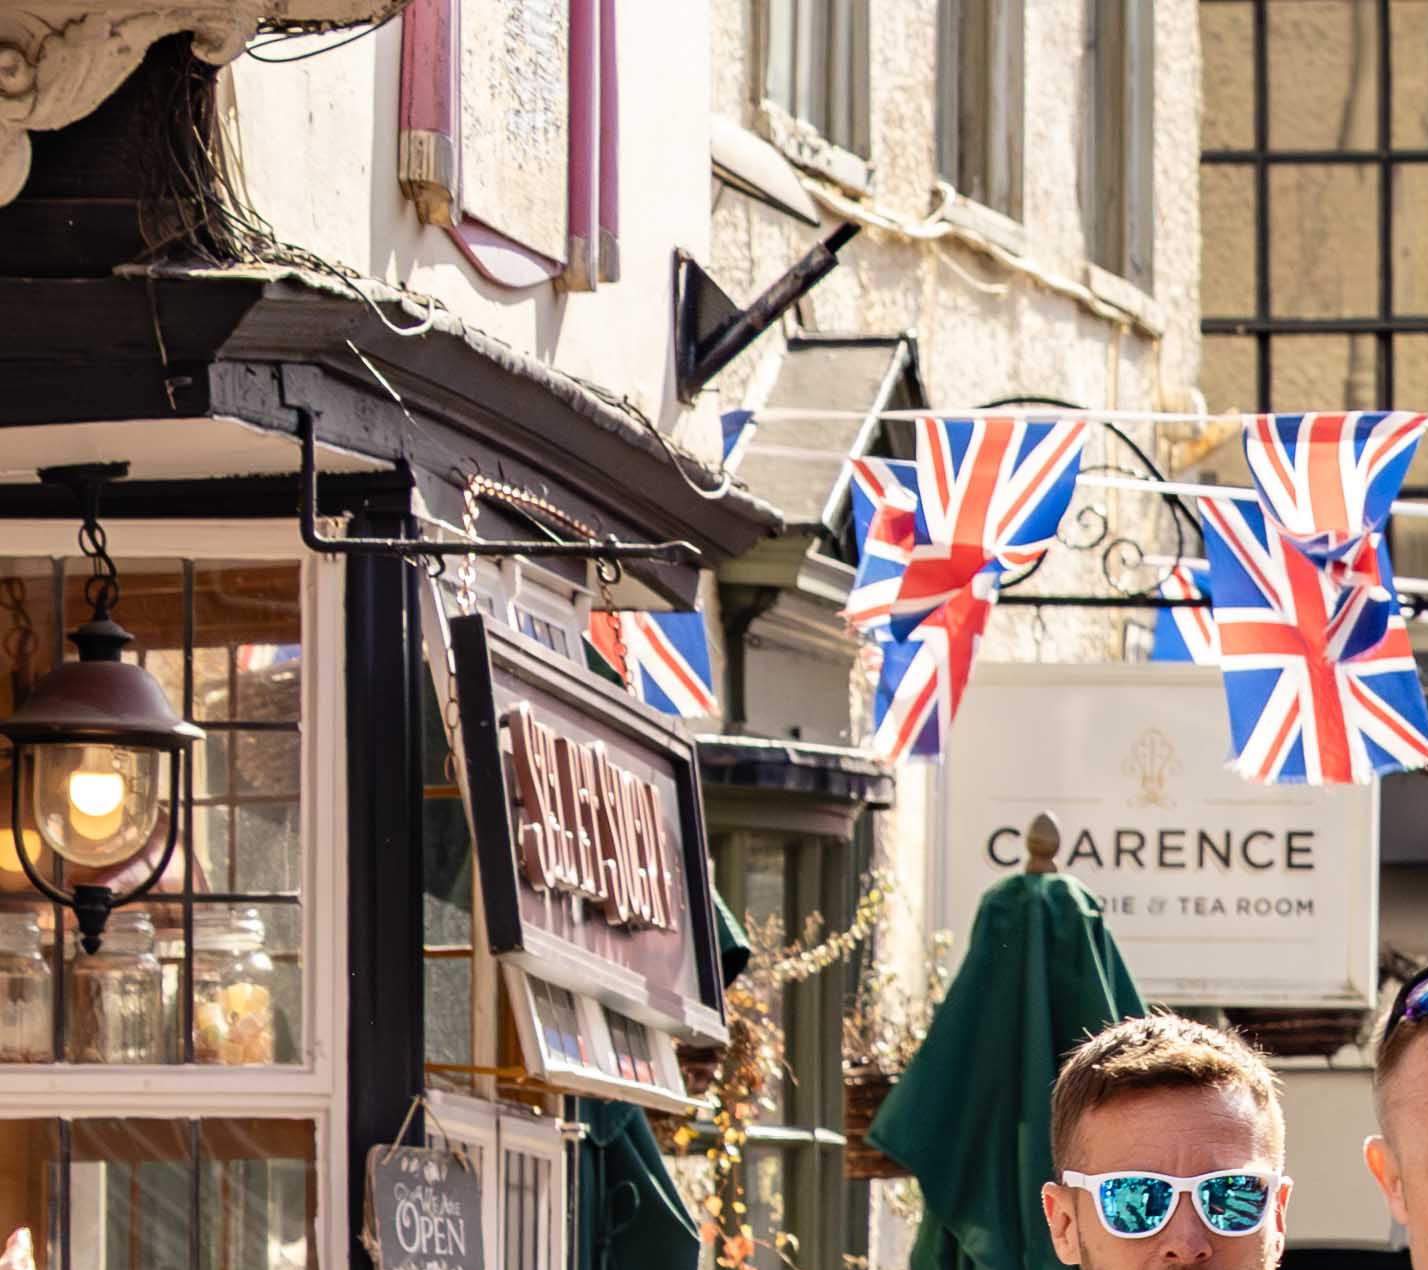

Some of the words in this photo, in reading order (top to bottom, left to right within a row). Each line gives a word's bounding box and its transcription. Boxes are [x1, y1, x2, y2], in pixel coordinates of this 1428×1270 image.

[986, 827, 1316, 871] CARENCE
[1178, 898, 1226, 916] TEA
[1236, 898, 1314, 916] ROOM
[394, 1199, 466, 1256] OPEN
